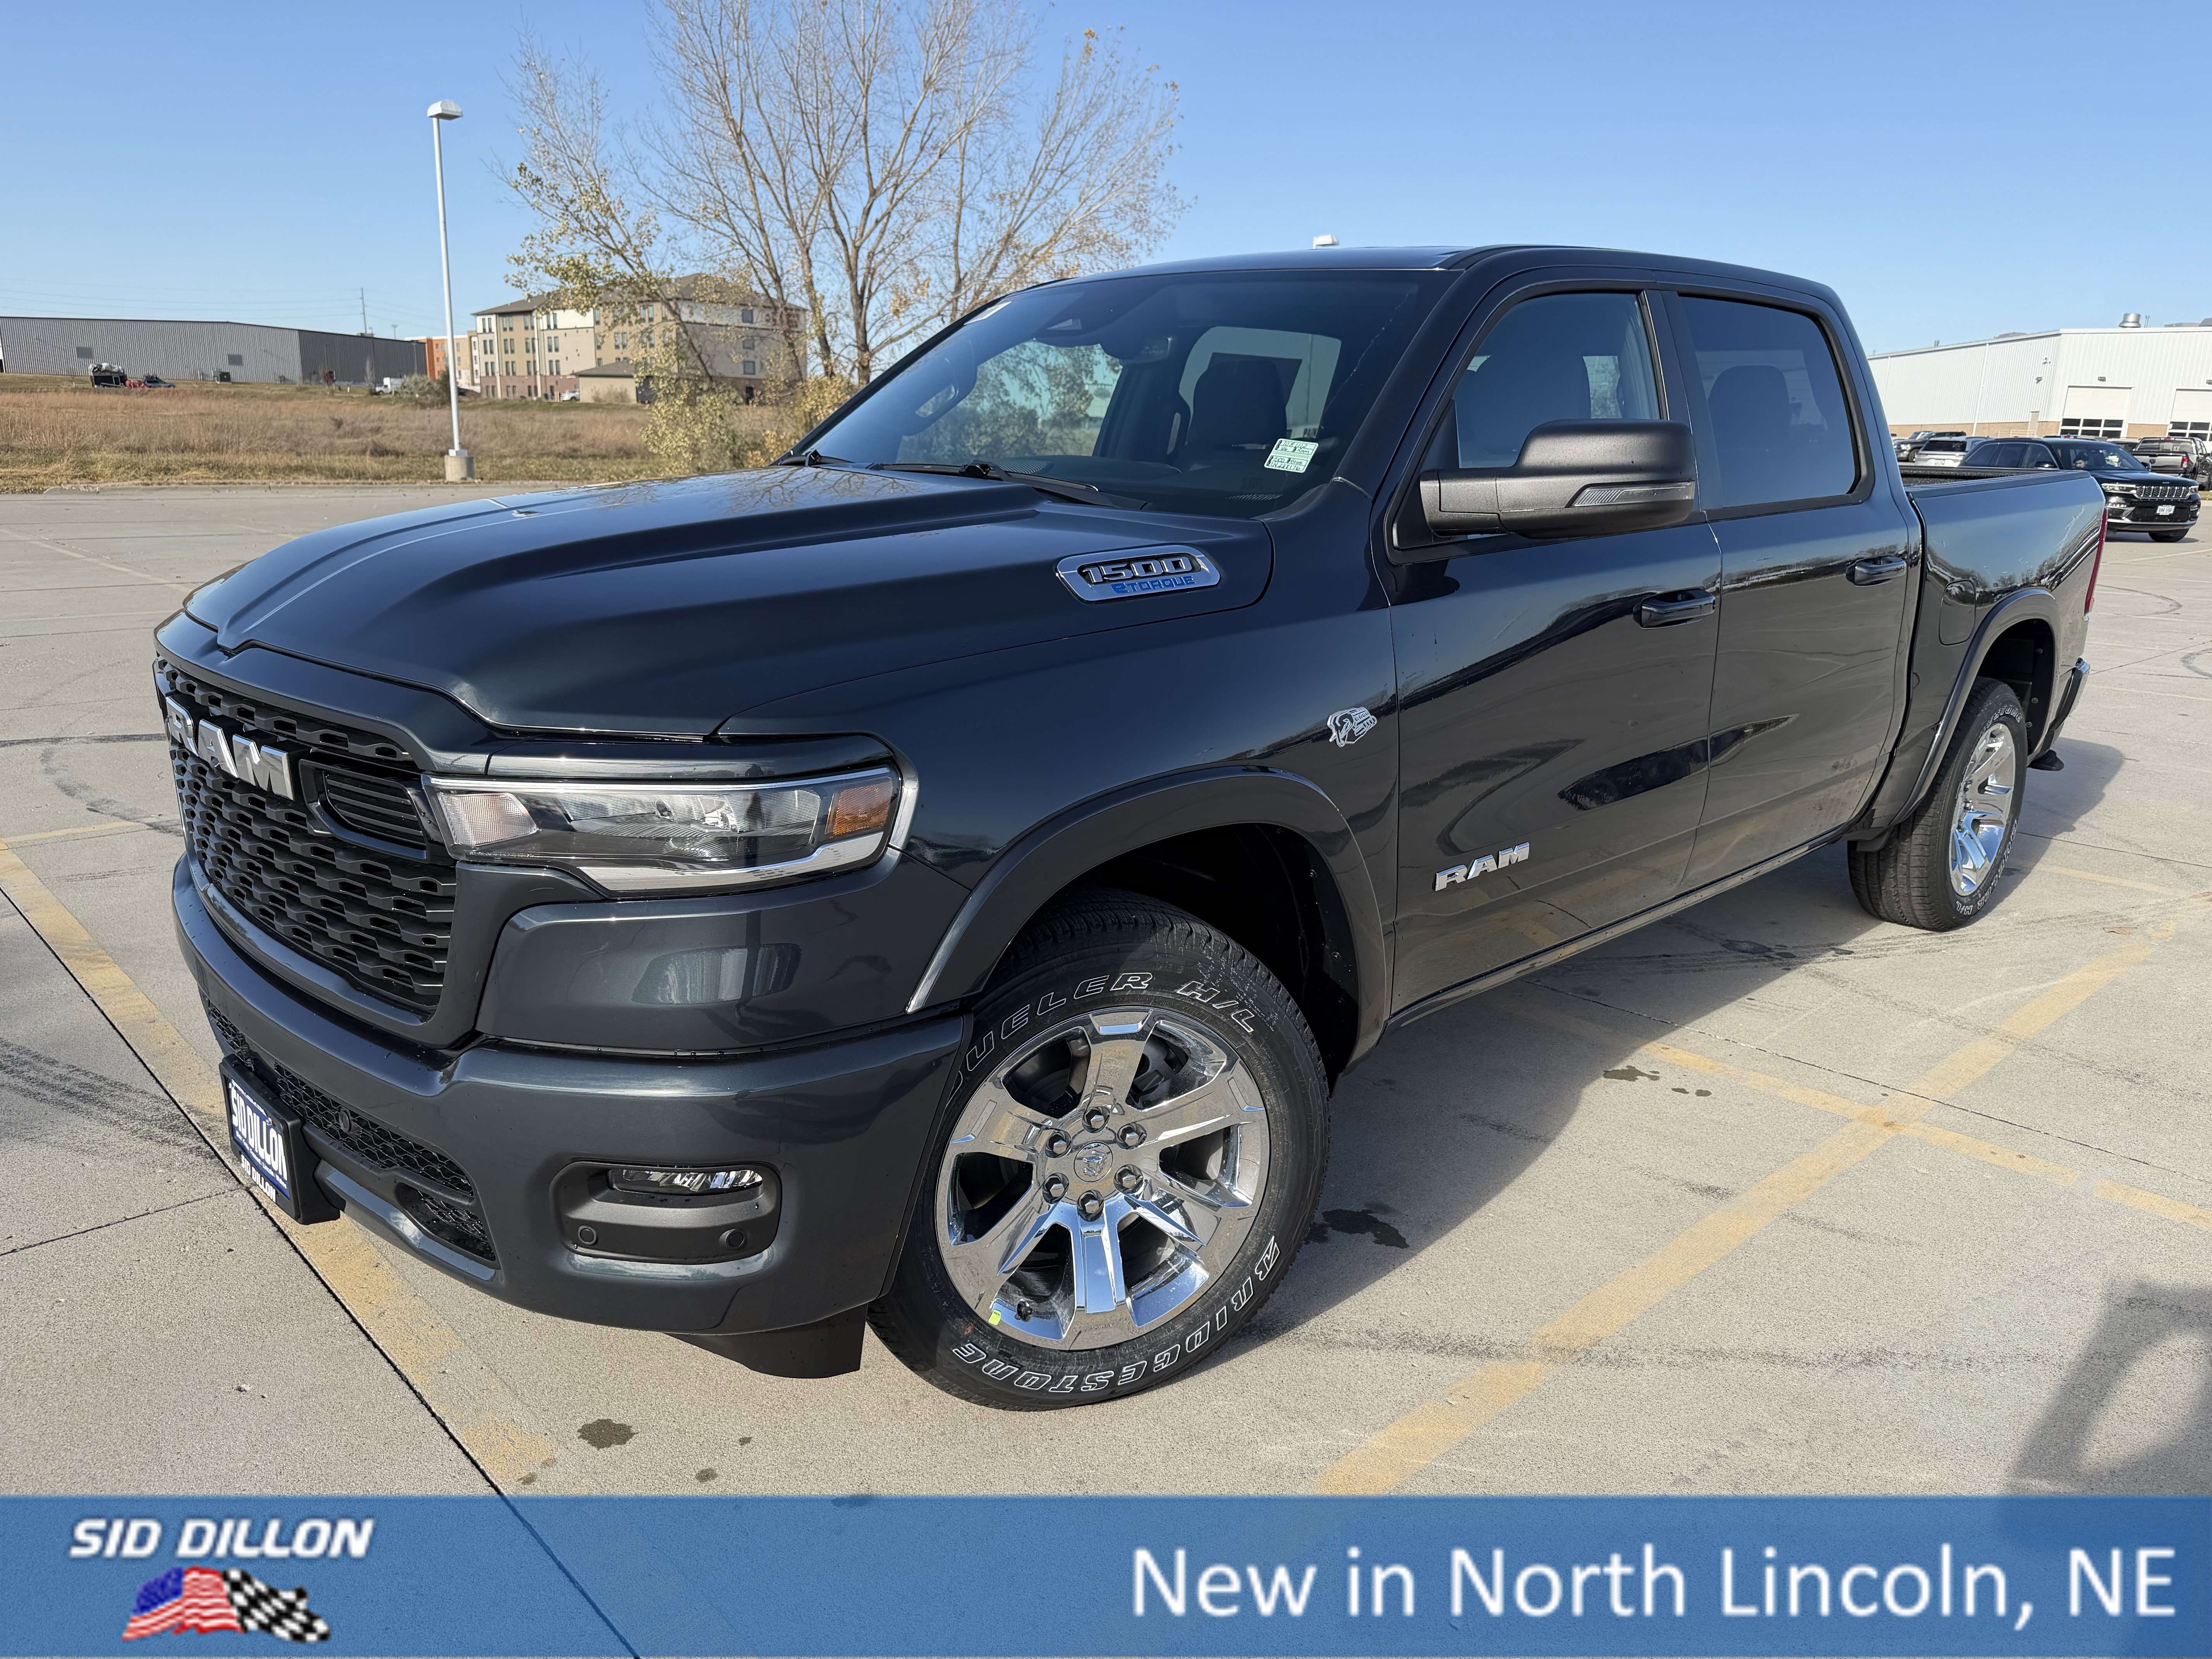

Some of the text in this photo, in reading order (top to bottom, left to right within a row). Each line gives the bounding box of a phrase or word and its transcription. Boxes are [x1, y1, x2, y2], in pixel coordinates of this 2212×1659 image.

[1083, 556, 1192, 583] 1500
[166, 697, 295, 802] RAM
[1433, 842, 1530, 891] RAM
[951, 972, 1153, 1096] UELER
[232, 1086, 247, 1139] SID
[247, 1105, 288, 1181] DILLON
[241, 1154, 251, 1176] SID
[252, 1166, 276, 1203] DILLON
[952, 1235, 1279, 1393] BRIDGESTONE
